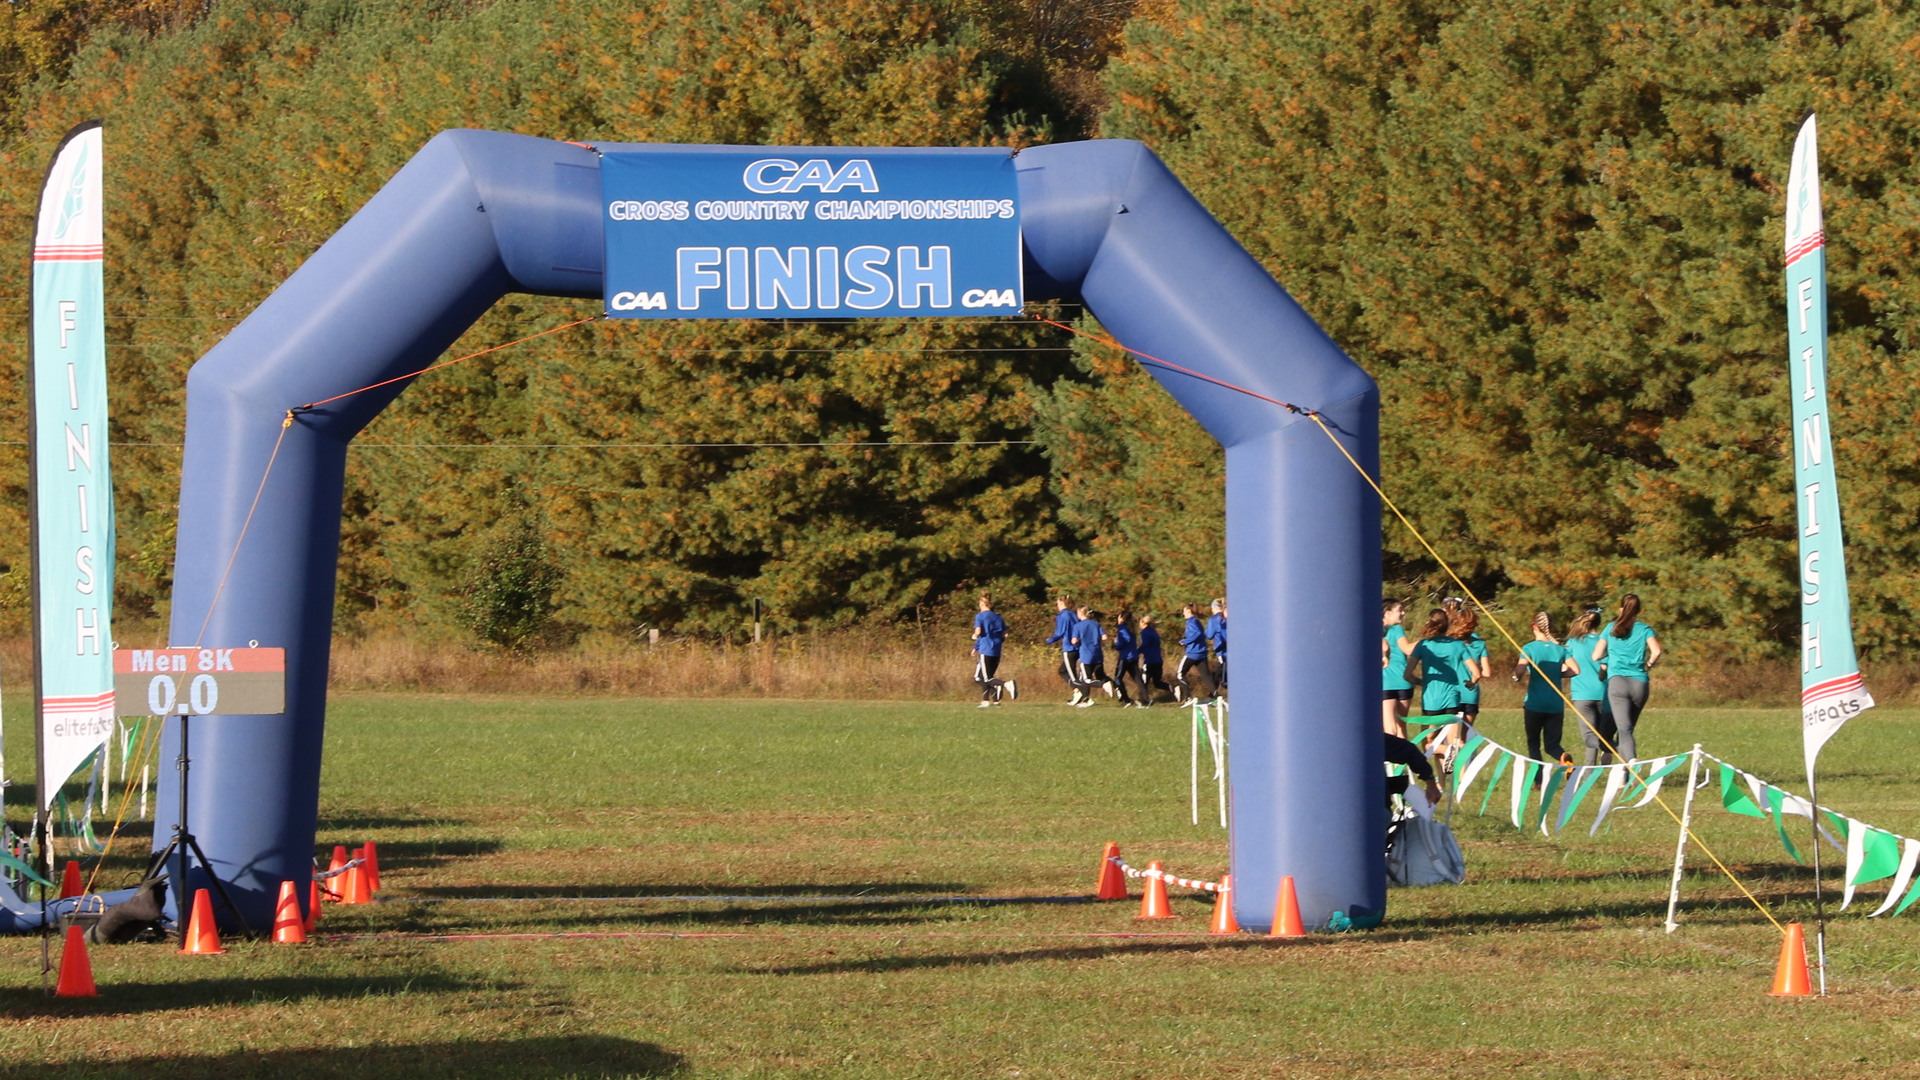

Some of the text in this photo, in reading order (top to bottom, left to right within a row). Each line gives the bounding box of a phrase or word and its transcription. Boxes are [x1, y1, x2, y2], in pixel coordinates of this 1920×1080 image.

[743, 158, 879, 194] CAA
[609, 199, 1015, 221] CROSS COUNTRY CHAMPIONSHIPS
[676, 245, 953, 310] FINISH
[611, 291, 668, 311] CAA
[961, 289, 1017, 309] CAA
[58, 301, 100, 656] FINISH
[1798, 277, 1823, 674] FINISH
[132, 649, 234, 672] Men 8K
[147, 674, 219, 716] 0.0
